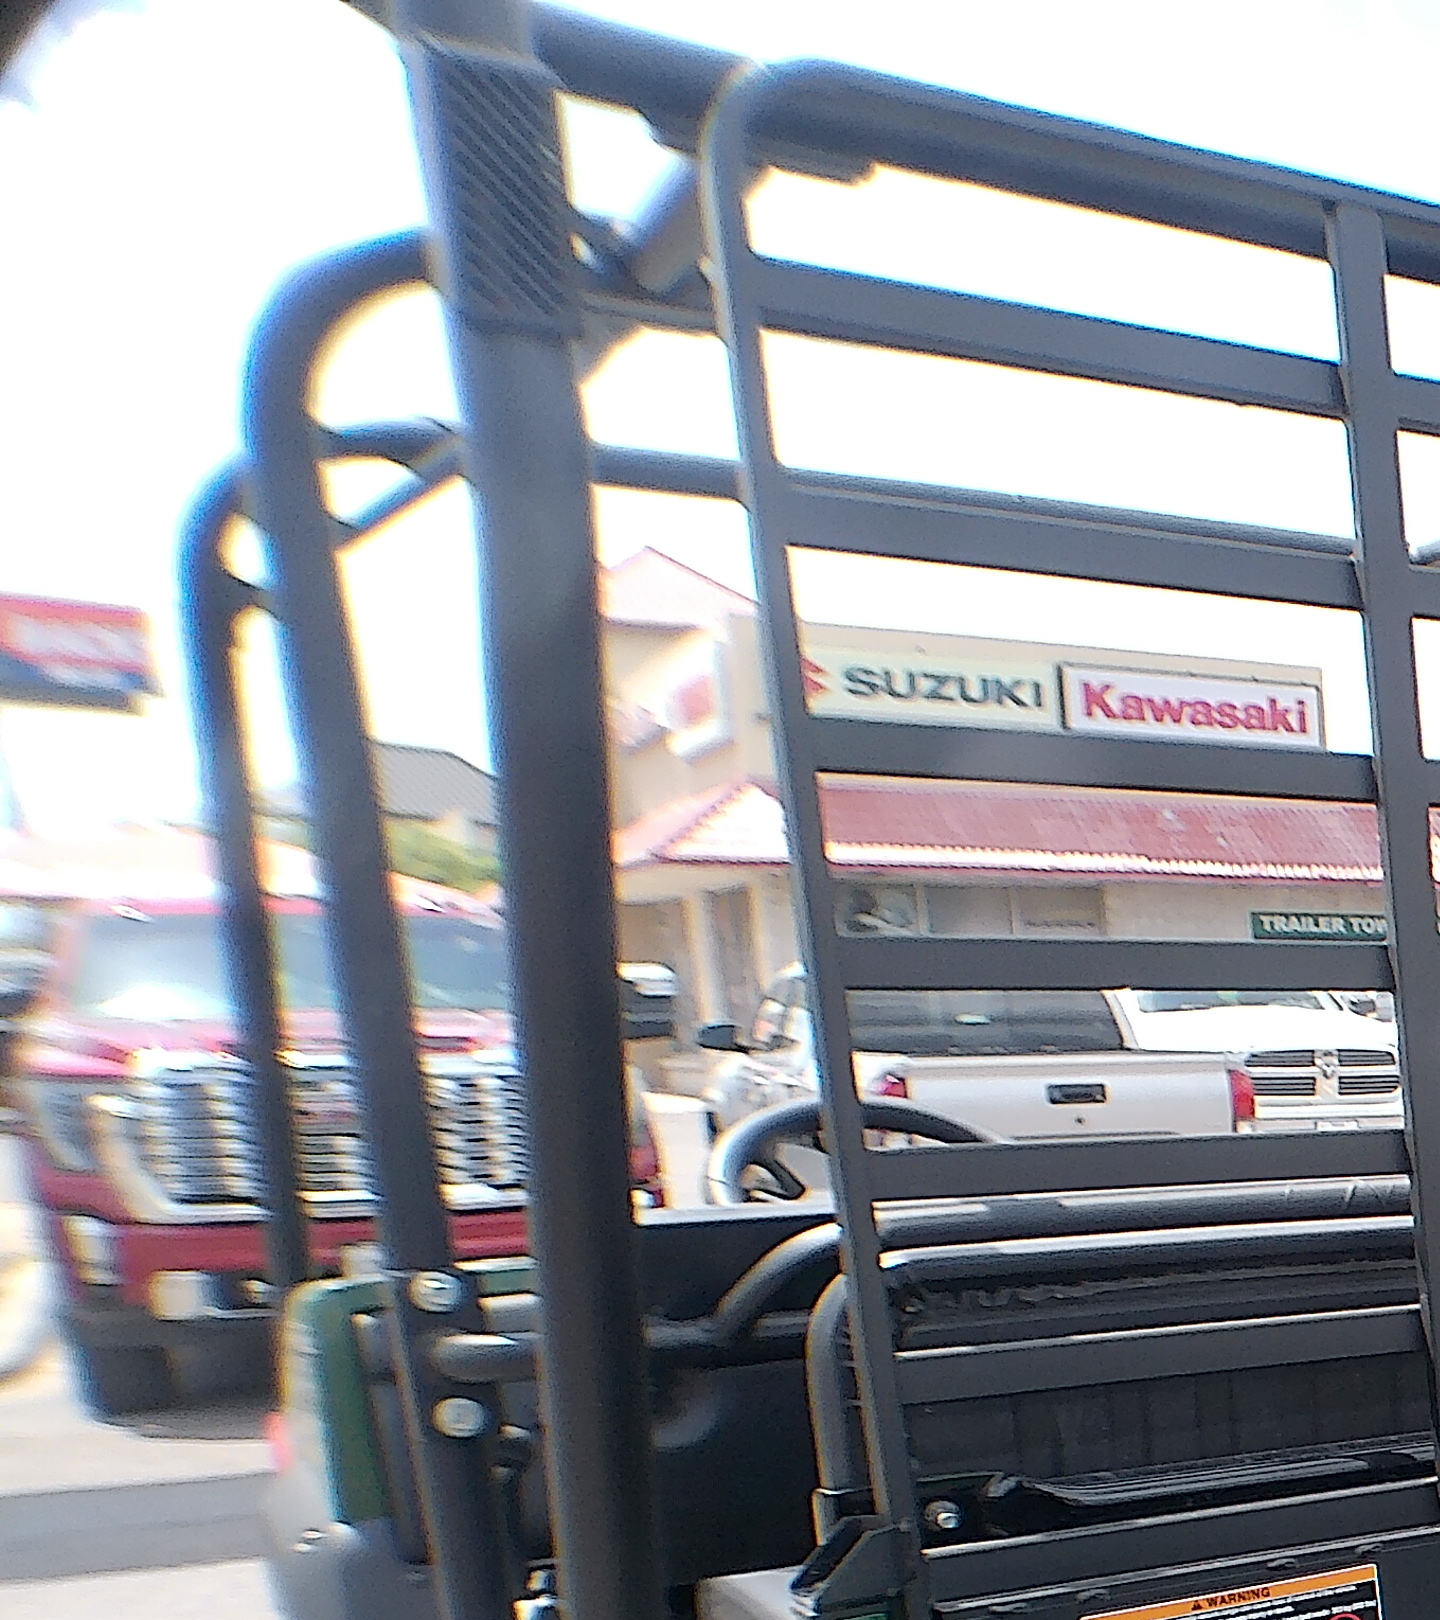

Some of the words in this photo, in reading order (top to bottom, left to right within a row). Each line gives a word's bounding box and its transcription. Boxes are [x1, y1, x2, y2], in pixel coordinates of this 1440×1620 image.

[844, 666, 1042, 708] SUZUKI
[1081, 680, 1308, 734] Kawasaki
[1260, 914, 1346, 934] TRAILER
[1206, 1586, 1270, 1607] WARNING
